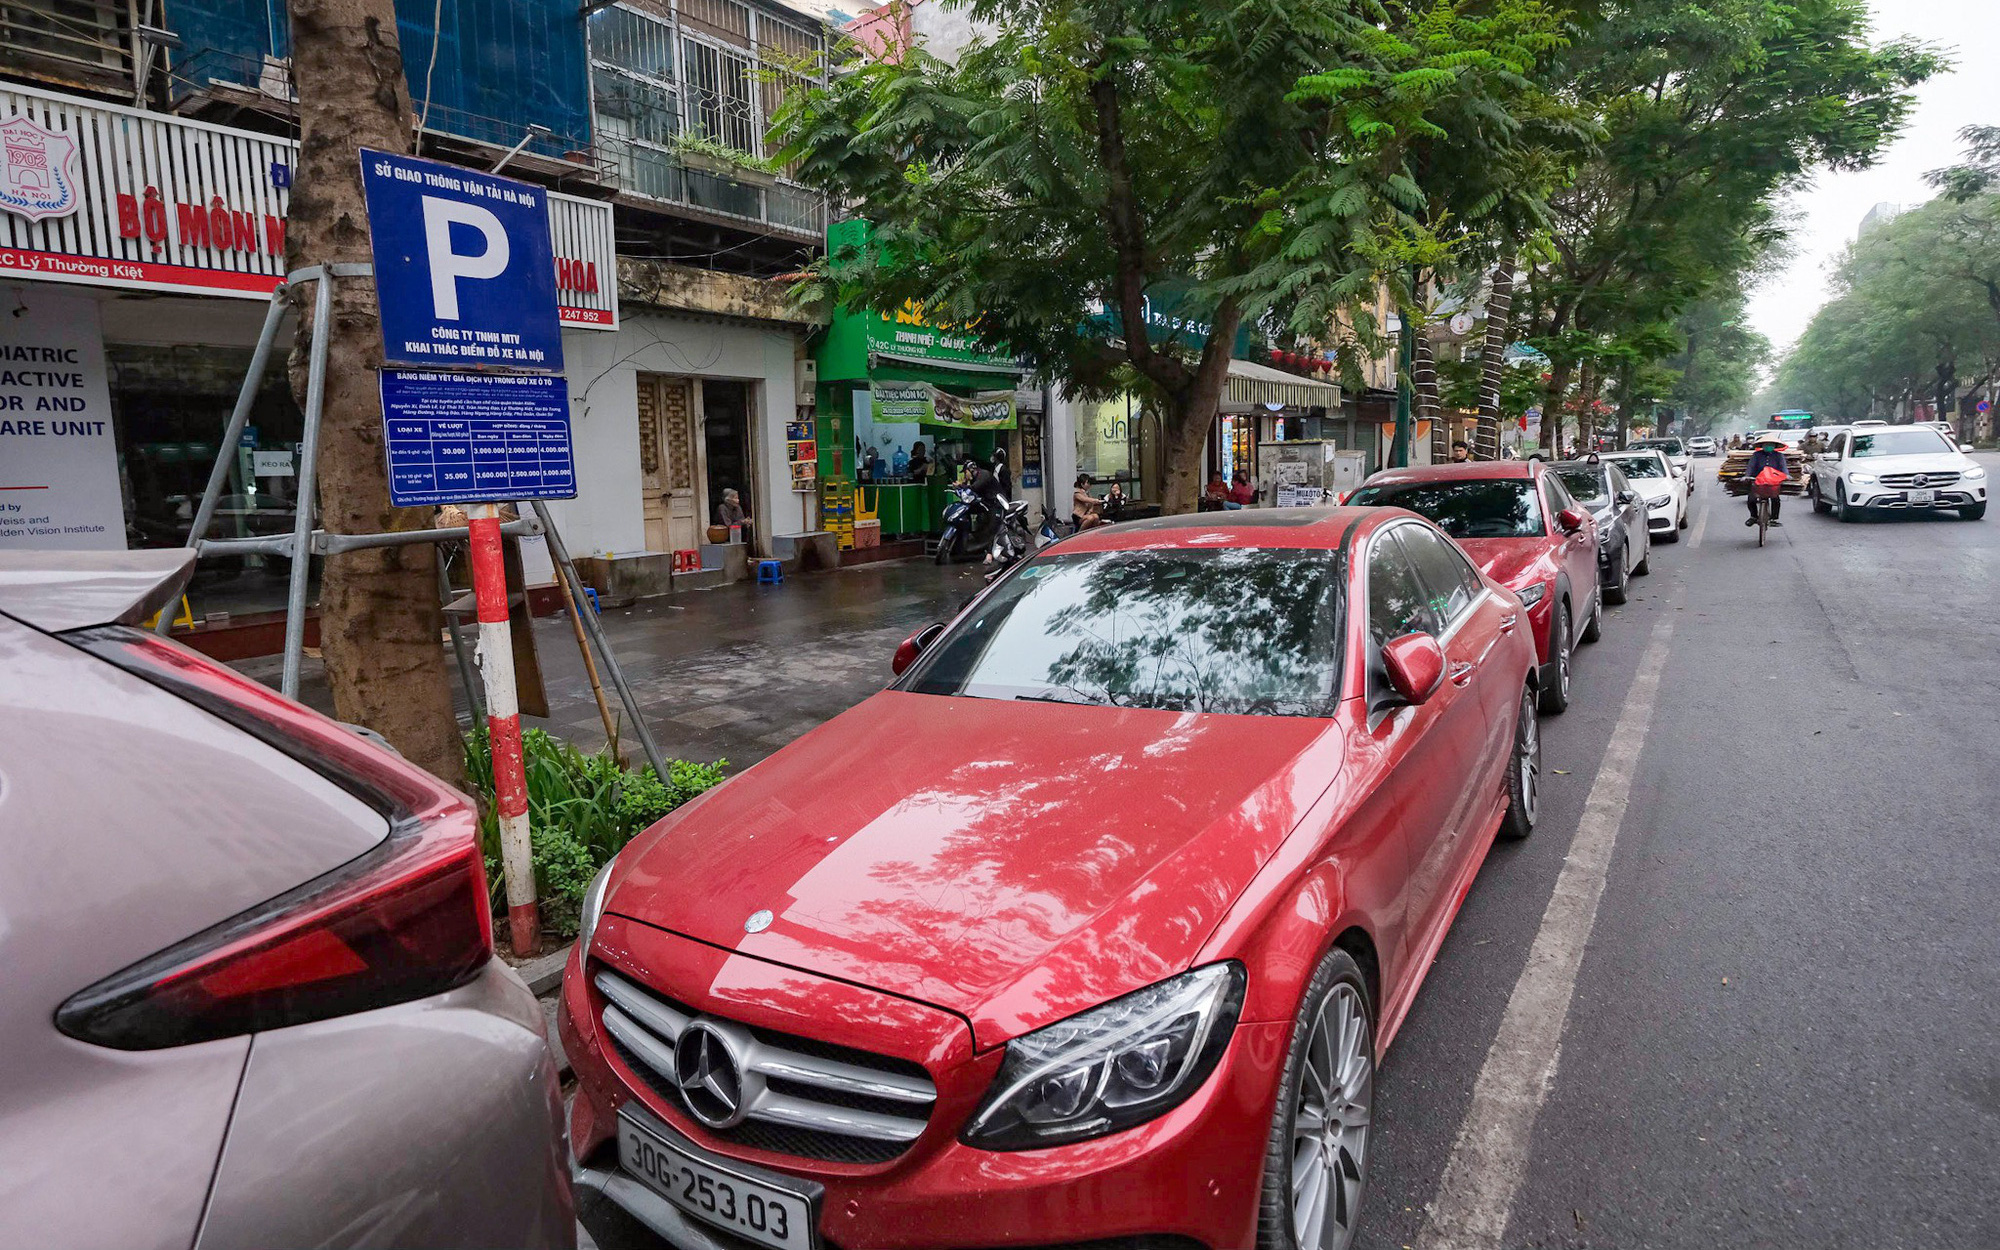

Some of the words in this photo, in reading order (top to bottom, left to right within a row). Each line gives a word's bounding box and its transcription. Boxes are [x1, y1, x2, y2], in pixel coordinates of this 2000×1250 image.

[6, 149, 48, 168] 1902
[375, 160, 392, 178] SỞ
[394, 167, 422, 184] GIAO
[424, 173, 461, 191] THÔNG
[463, 181, 484, 196] VẬN
[485, 183, 502, 200] TẢI
[503, 190, 518, 203] HÀ
[518, 193, 536, 208] NỘI
[117, 185, 168, 254] BỘ
[177, 194, 256, 254] MÔN
[422, 195, 510, 321] P
[20, 255, 40, 270] Lý
[44, 257, 109, 277] Thường
[113, 264, 144, 280] Kiệt
[565, 310, 580, 319] 247
[583, 311, 599, 321] 952
[431, 326, 460, 340] CÔNG
[461, 330, 473, 341] TY
[475, 331, 500, 343] TNHH
[501, 333, 520, 345] MTV
[0, 345, 79, 364] IATRIC
[405, 341, 430, 354] KHAI
[432, 342, 458, 355] THÁC
[460, 342, 485, 356] ĐIỂM
[501, 348, 514, 359] XE
[515, 348, 528, 360] HÀ
[529, 349, 544, 363] NỘI
[875, 341, 890, 350] 42C
[1, 370, 84, 388] ACTIVE
[396, 371, 418, 381] BẢNG
[453, 373, 465, 382] GIÁ
[483, 377, 493, 386] VỤ
[36, 396, 86, 412] AND
[0, 420, 46, 436] ARE
[51, 421, 106, 436] UNIT
[8, 504, 21, 512] by
[29, 516, 49, 524] and
[27, 527, 60, 535] Vision
[64, 525, 105, 533] Institute
[629, 1132, 789, 1240] 30G-253.03
